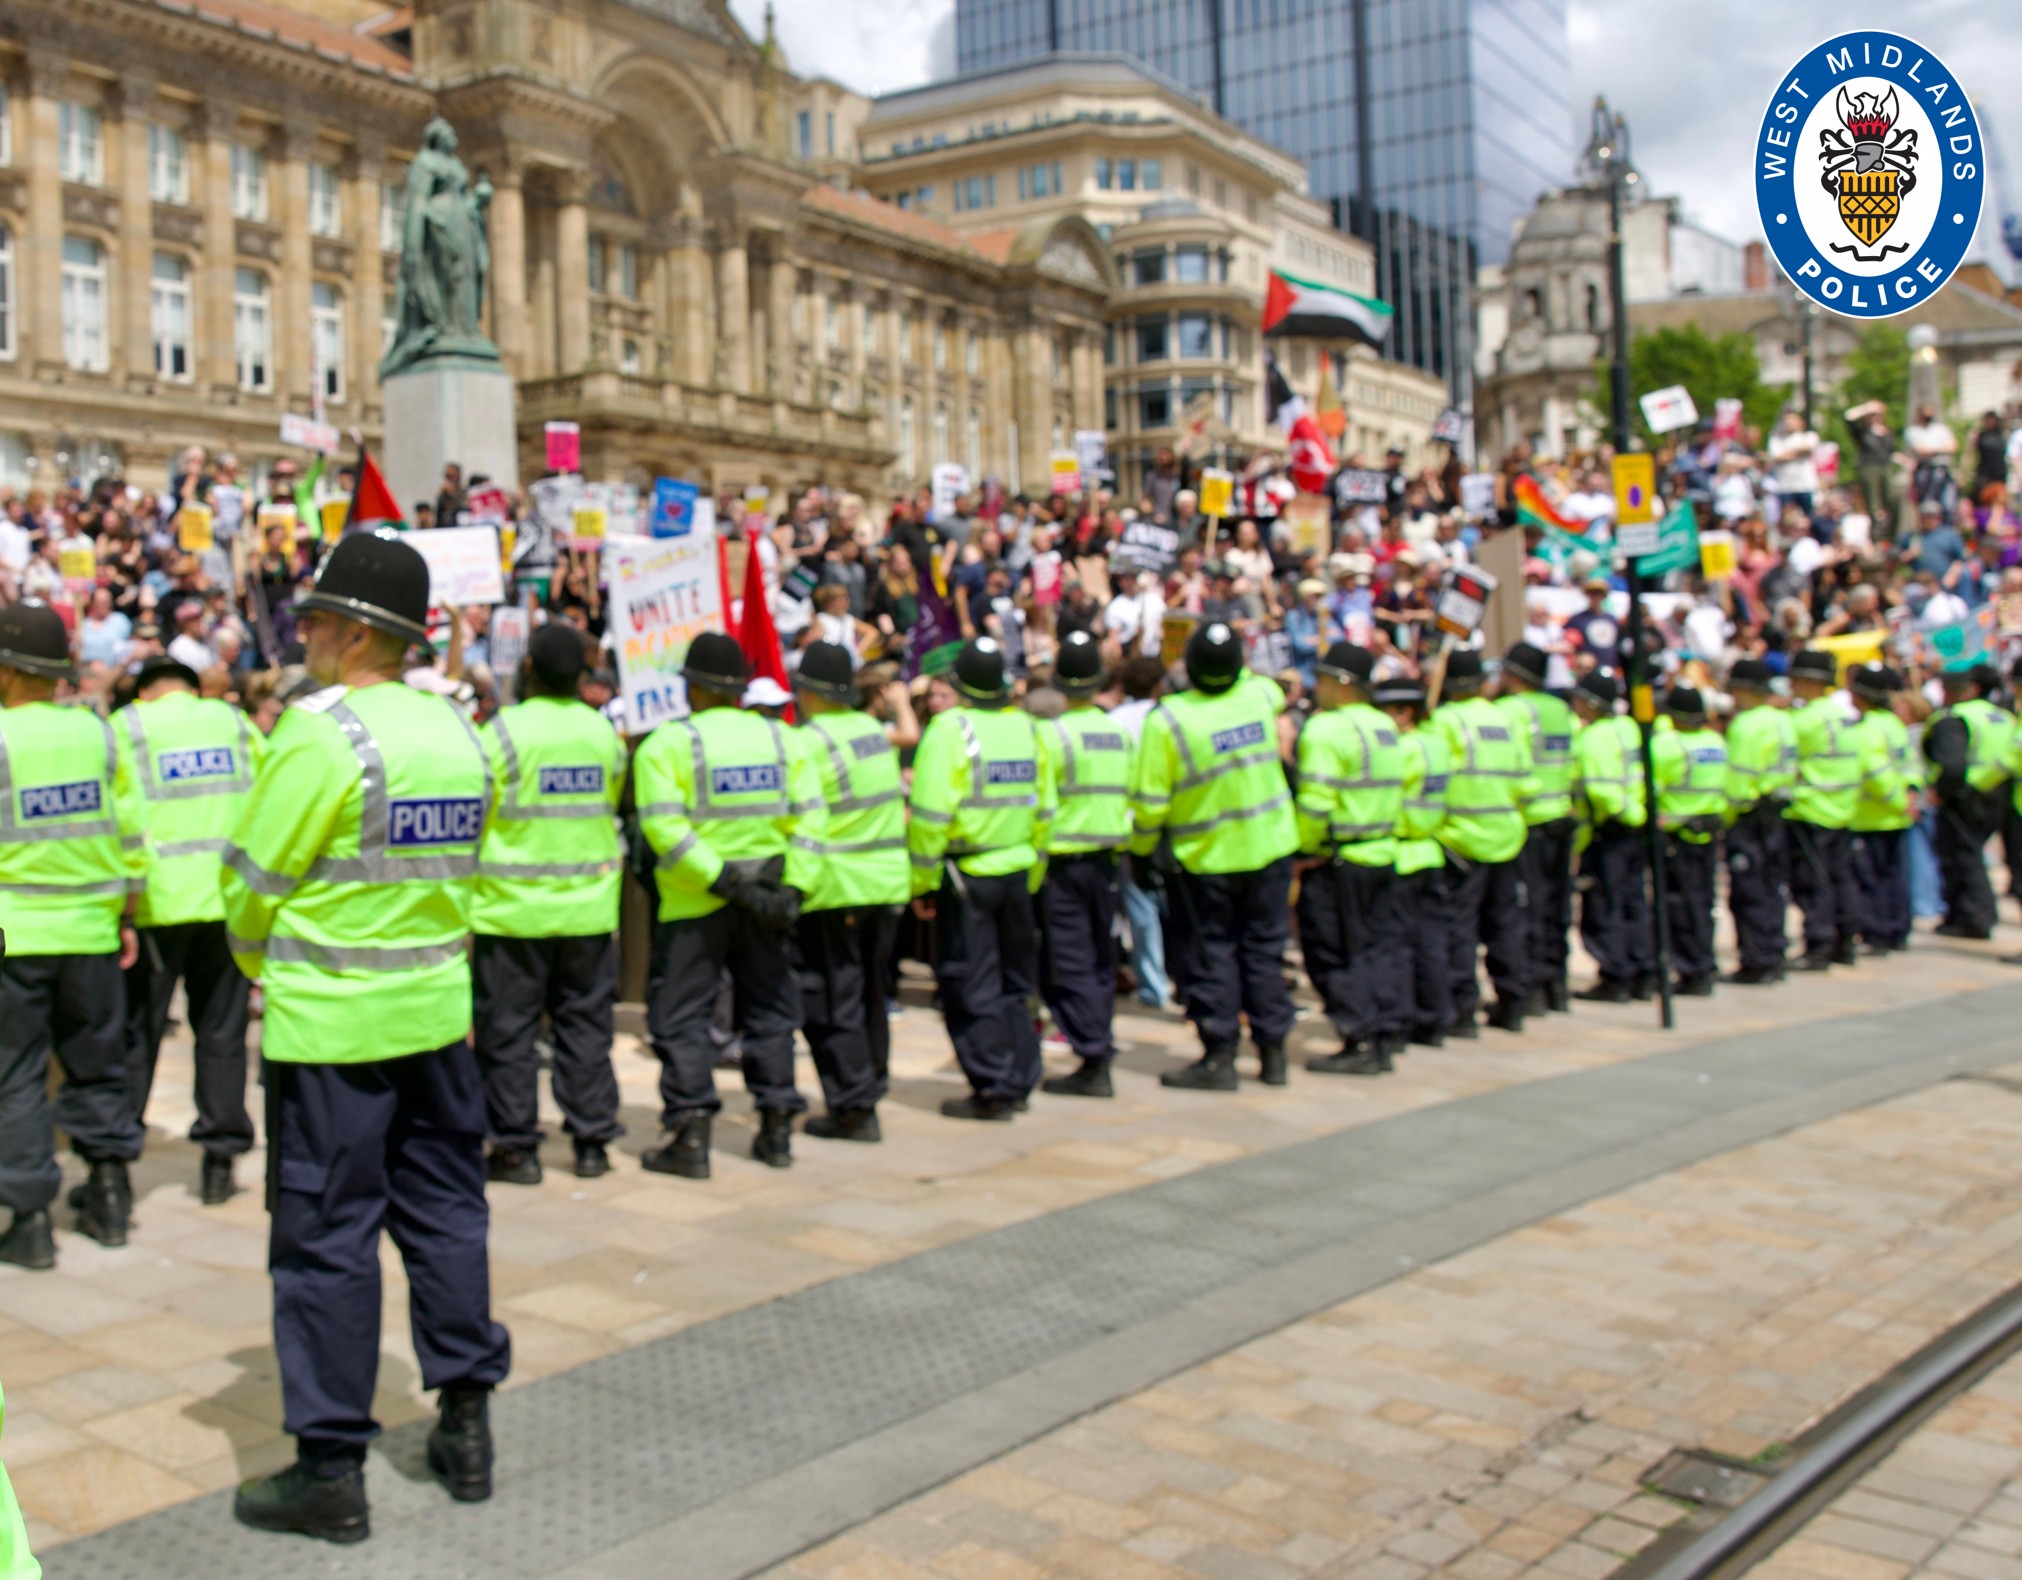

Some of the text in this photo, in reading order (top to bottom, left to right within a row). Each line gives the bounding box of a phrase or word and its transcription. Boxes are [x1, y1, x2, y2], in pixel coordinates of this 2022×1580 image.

[628, 579, 701, 632] UNITE
[160, 749, 234, 780] POLICE
[542, 768, 600, 793] POLICE
[715, 766, 775, 792] POLICE
[22, 781, 99, 818] POLICE
[393, 803, 481, 840] POLICE
